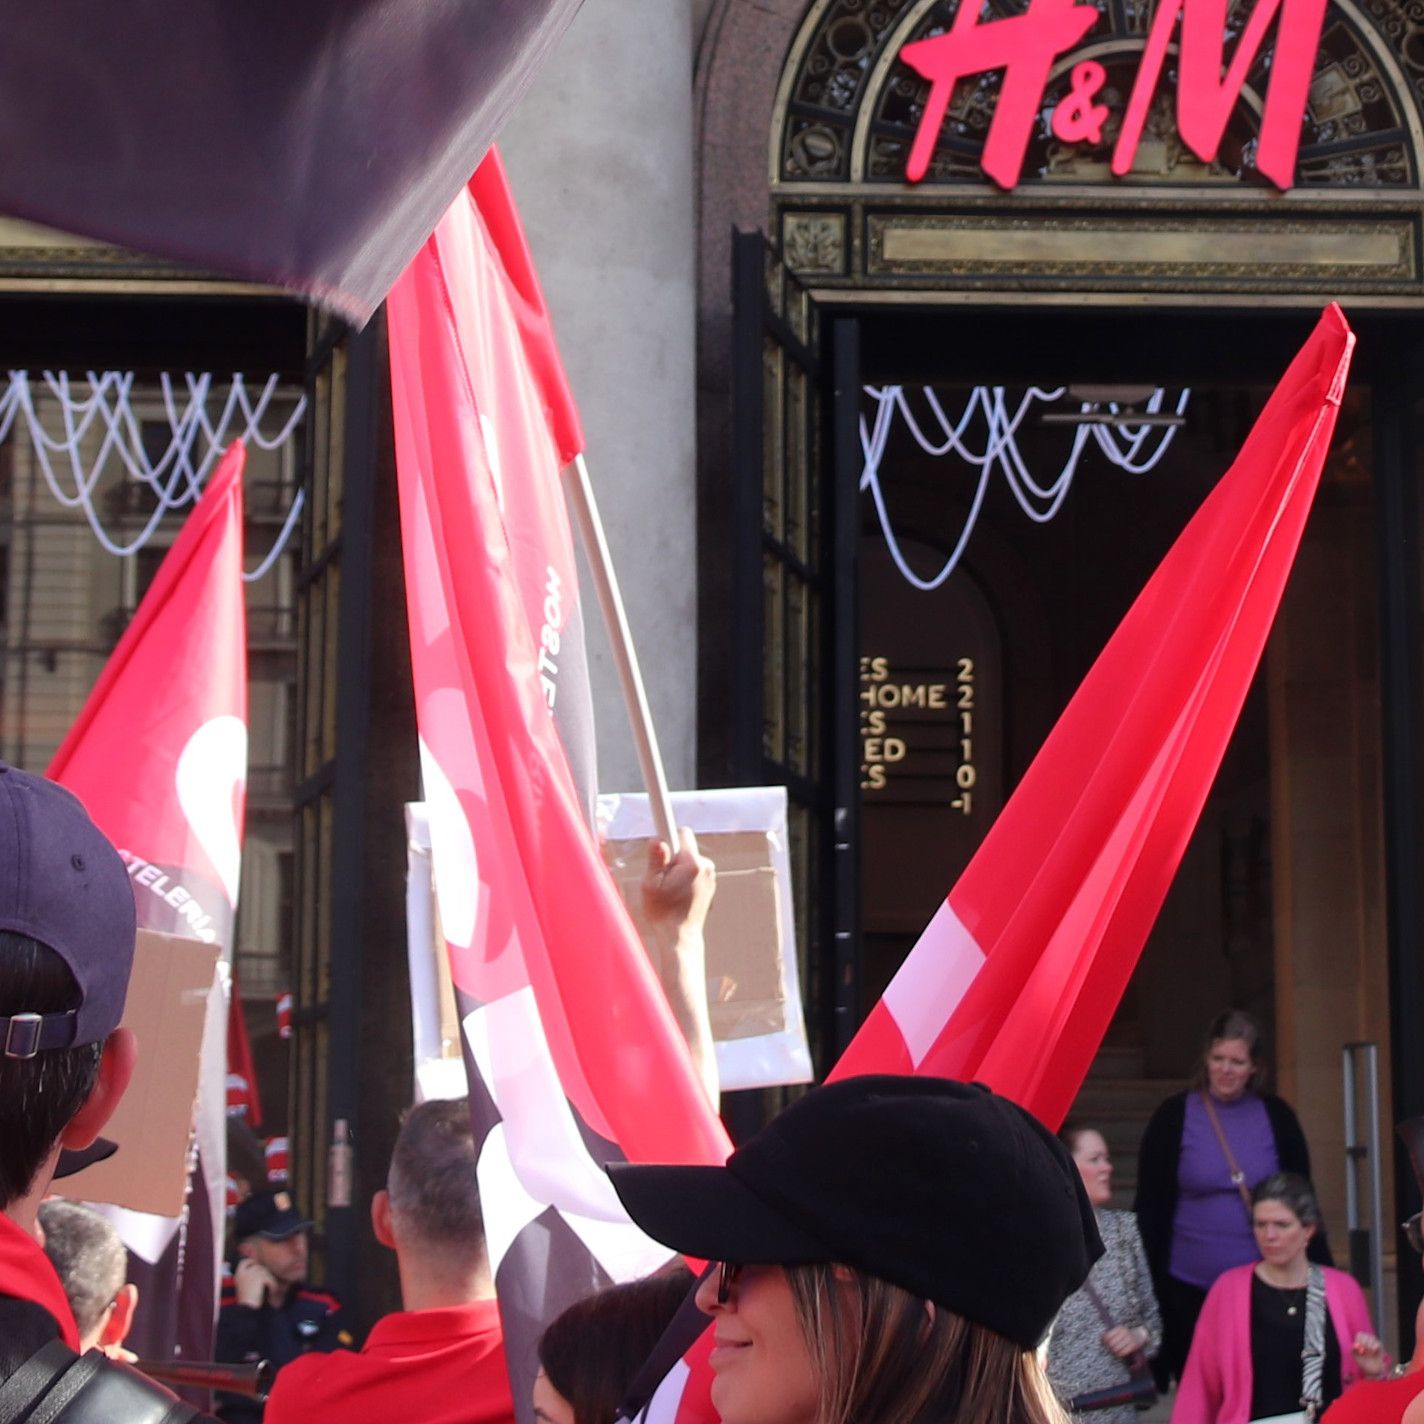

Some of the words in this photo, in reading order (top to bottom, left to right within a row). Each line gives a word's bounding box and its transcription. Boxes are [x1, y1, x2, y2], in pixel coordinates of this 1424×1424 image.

[956, 657, 974, 682] 2
[956, 684, 974, 709] 2
[960, 711, 973, 735] 1
[960, 738, 973, 762] 1
[956, 764, 976, 789] 0
